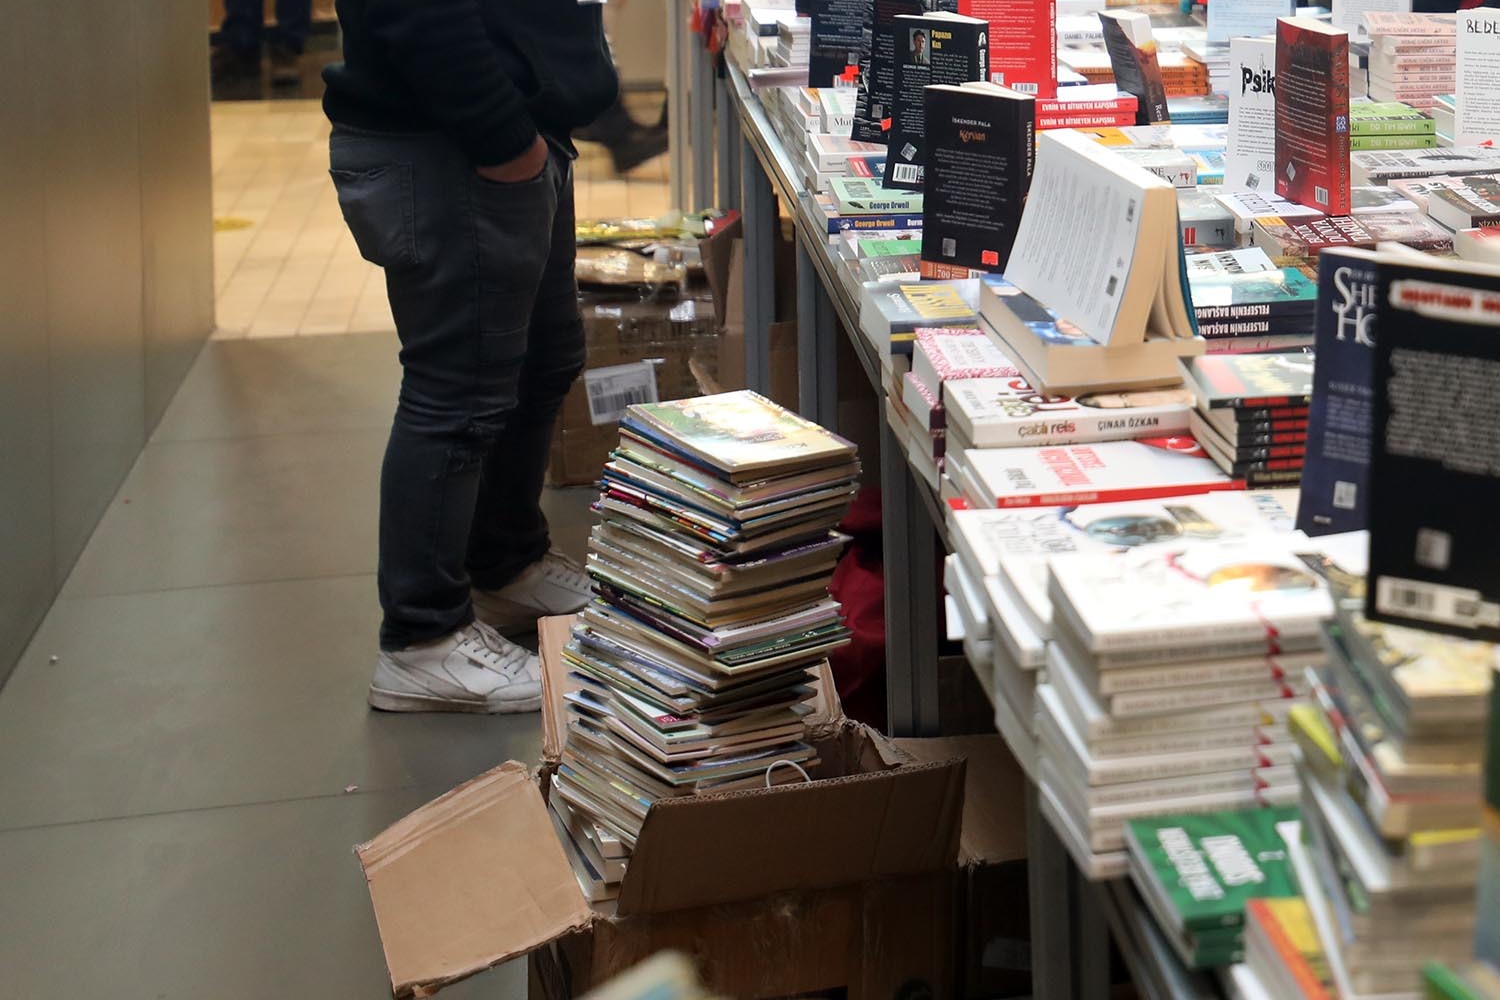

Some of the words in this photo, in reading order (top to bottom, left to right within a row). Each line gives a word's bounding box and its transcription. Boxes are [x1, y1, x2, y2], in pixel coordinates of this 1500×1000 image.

[951, 116, 977, 126] İSKENDER
[977, 120, 991, 128] PALA
[869, 201, 890, 210] George
[891, 201, 910, 209] Orwell
[854, 218, 876, 228] George
[876, 218, 895, 227] Orwell
[1230, 304, 1271, 320] FELSEFENİN
[1229, 320, 1270, 336] FELSEFENİN
[1050, 420, 1076, 434] reis
[1097, 418, 1126, 432] ÇINAR
[1127, 414, 1159, 429] ÖZKAN
